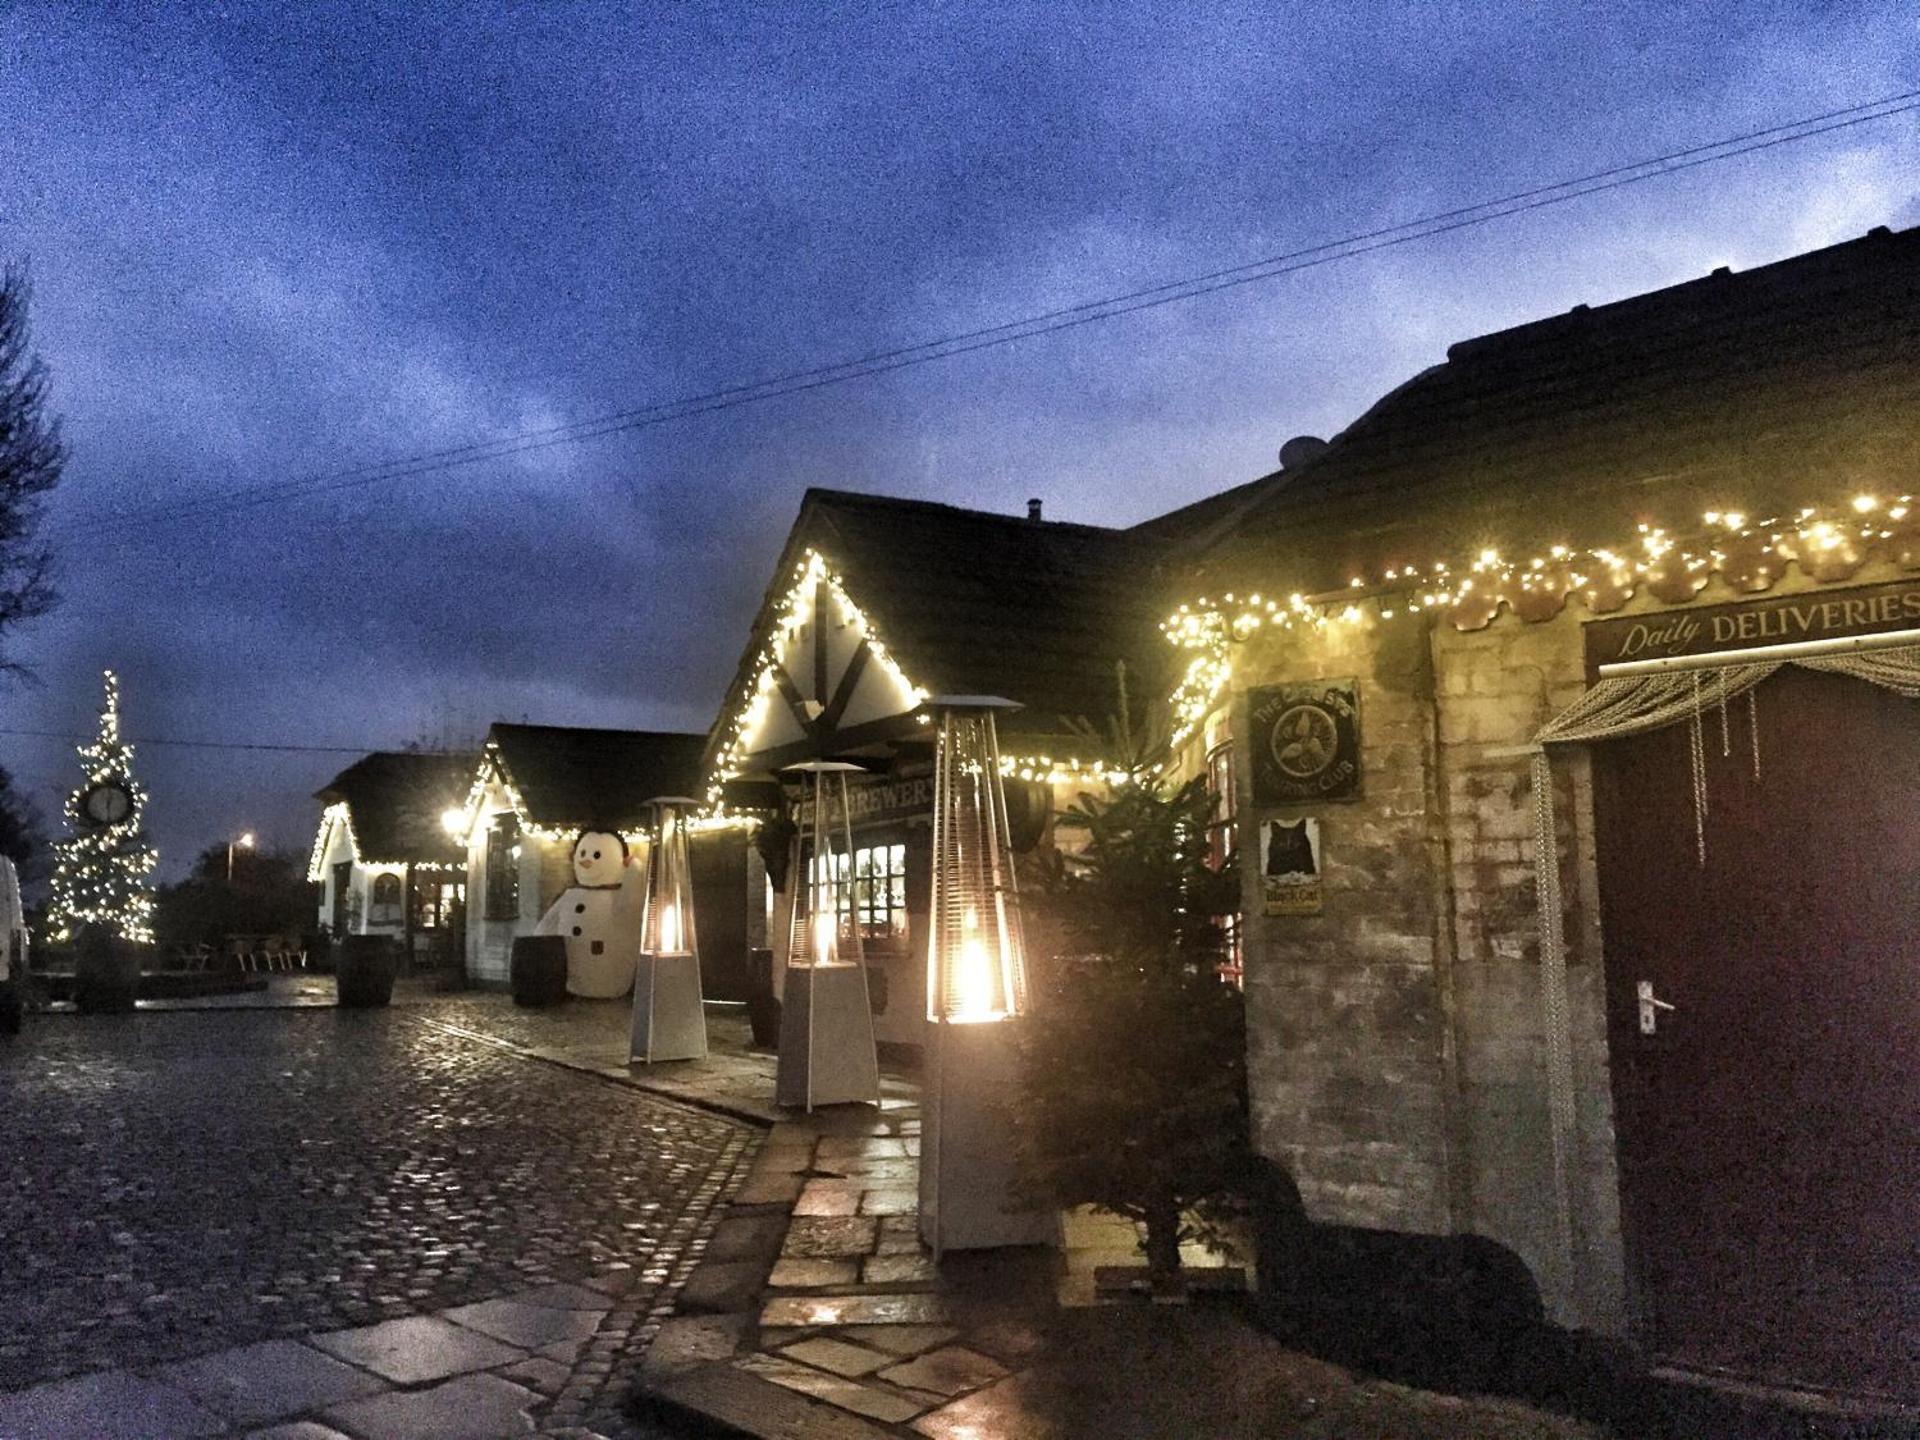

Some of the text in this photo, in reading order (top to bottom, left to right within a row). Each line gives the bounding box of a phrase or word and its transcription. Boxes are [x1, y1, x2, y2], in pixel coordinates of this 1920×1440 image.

[1618, 592, 1920, 657] Daily DELIVERIES
[847, 778, 936, 815] BREWER
